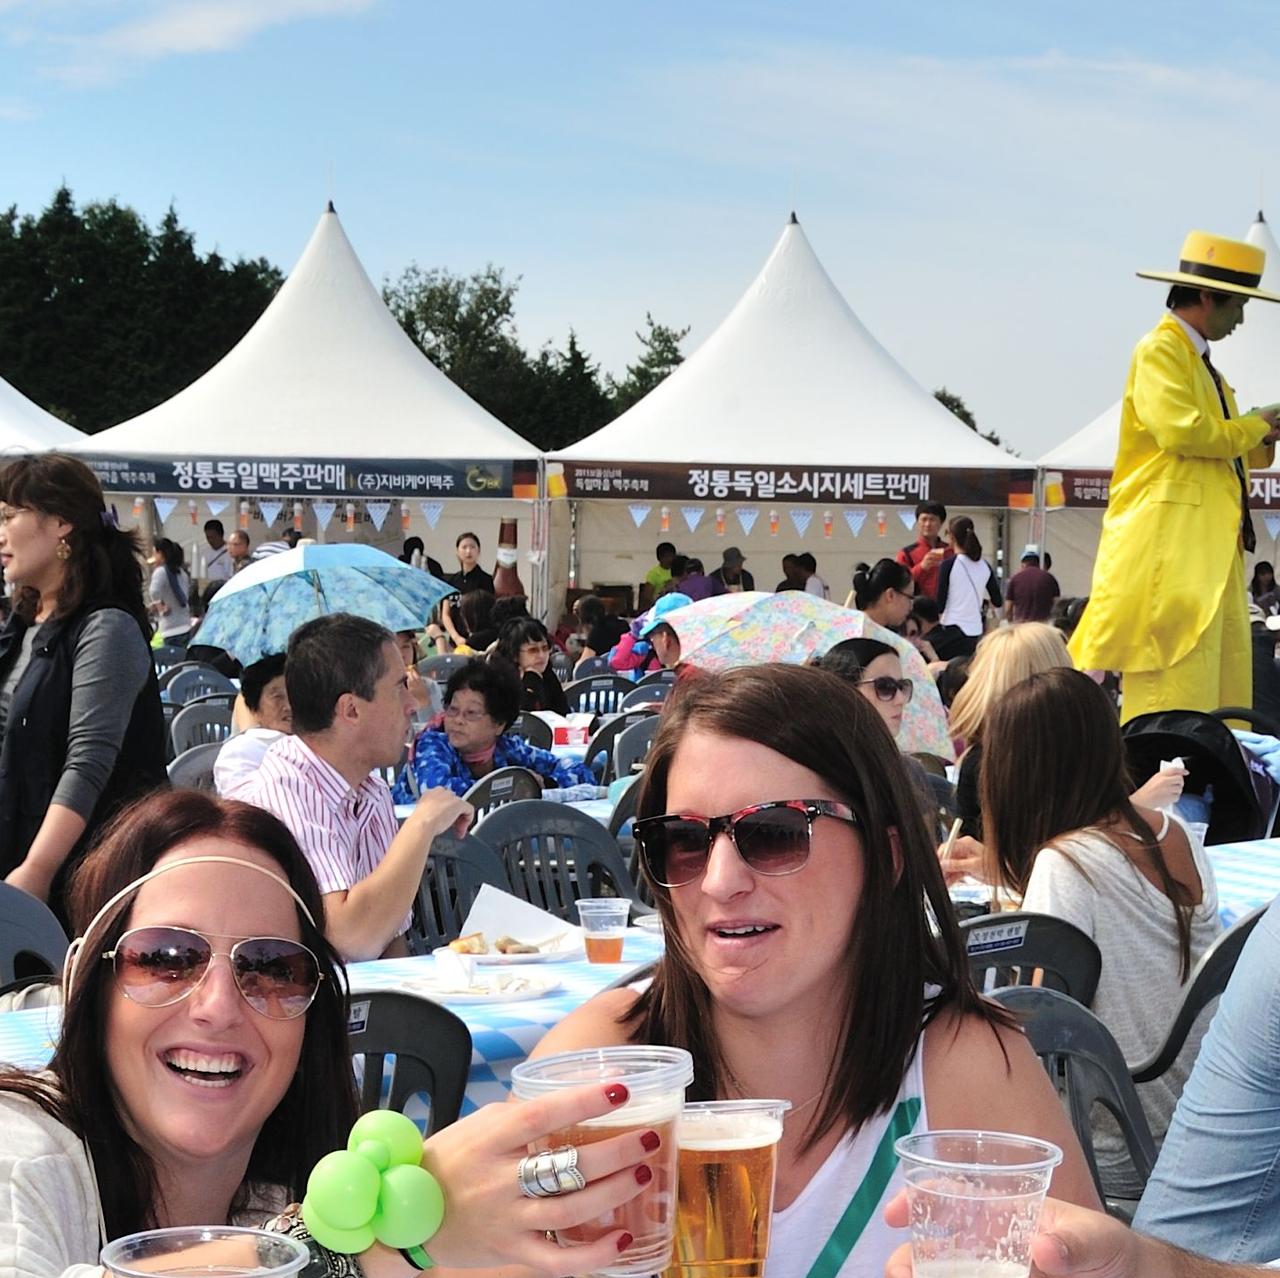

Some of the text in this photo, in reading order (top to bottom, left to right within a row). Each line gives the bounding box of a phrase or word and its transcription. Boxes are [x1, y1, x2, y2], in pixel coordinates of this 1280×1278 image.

[172, 461, 346, 490] 정통독일맥주판매
[357, 473, 454, 491] (주)지비케이맥주
[688, 469, 930, 500] 정통독일소시지세트판매
